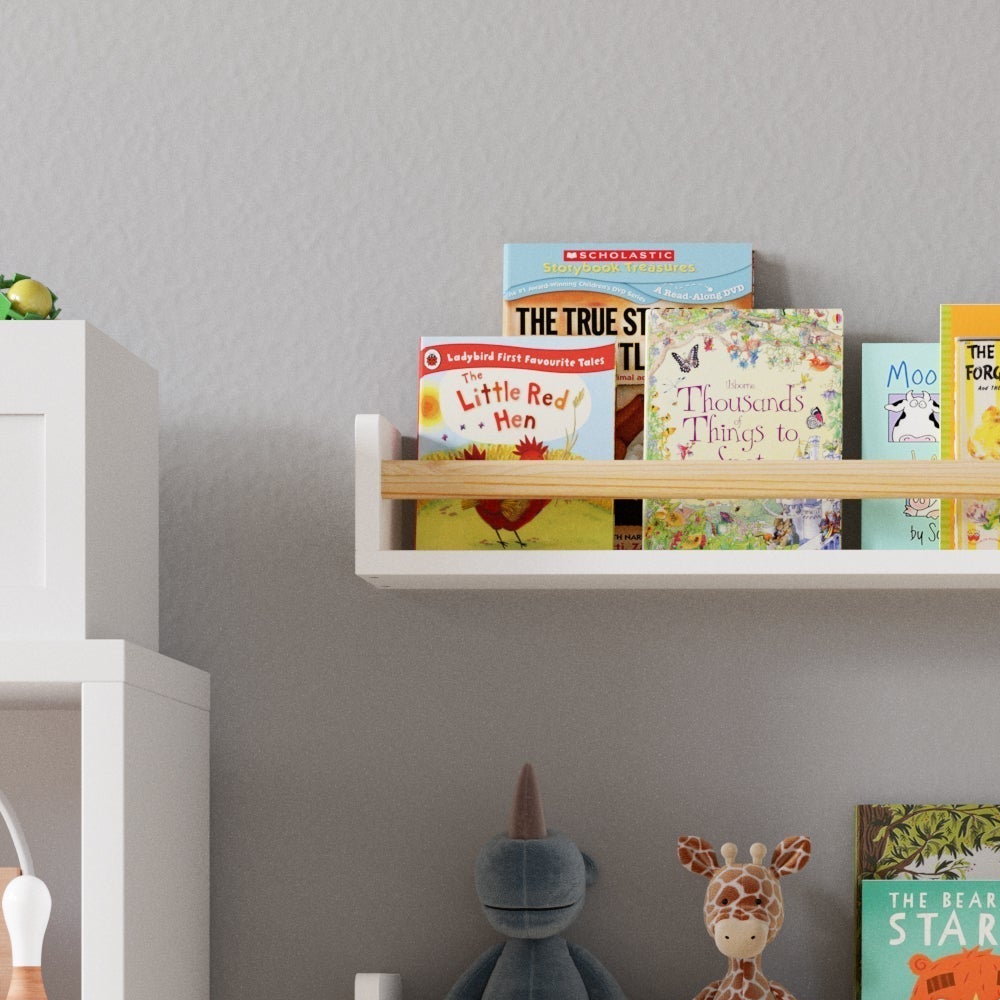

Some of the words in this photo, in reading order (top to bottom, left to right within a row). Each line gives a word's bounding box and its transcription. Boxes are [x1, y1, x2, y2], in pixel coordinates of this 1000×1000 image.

[579, 251, 673, 260] SCHOLASTIC
[543, 262, 620, 275] Storybook
[625, 261, 696, 273] Treasures
[653, 286, 662, 295] A
[664, 288, 723, 301] Read-Along
[724, 284, 745, 298] DVD
[516, 307, 558, 336] THE
[563, 307, 618, 336] TRUE
[447, 351, 495, 364] Ladybird
[497, 352, 521, 363] First
[524, 355, 576, 367] Favourite
[578, 357, 604, 367] Tales
[966, 345, 995, 360] THE
[462, 370, 483, 384] The
[886, 360, 937, 388] Moo
[456, 380, 521, 411] Little
[528, 382, 570, 410] Red
[677, 384, 804, 413] Thousands
[493, 409, 536, 432] Hen
[734, 415, 743, 428] of
[683, 414, 765, 452] Things
[777, 423, 799, 441] to
[910, 525, 924, 545] by
[889, 892, 928, 909] THE
[942, 891, 996, 909] BEAR
